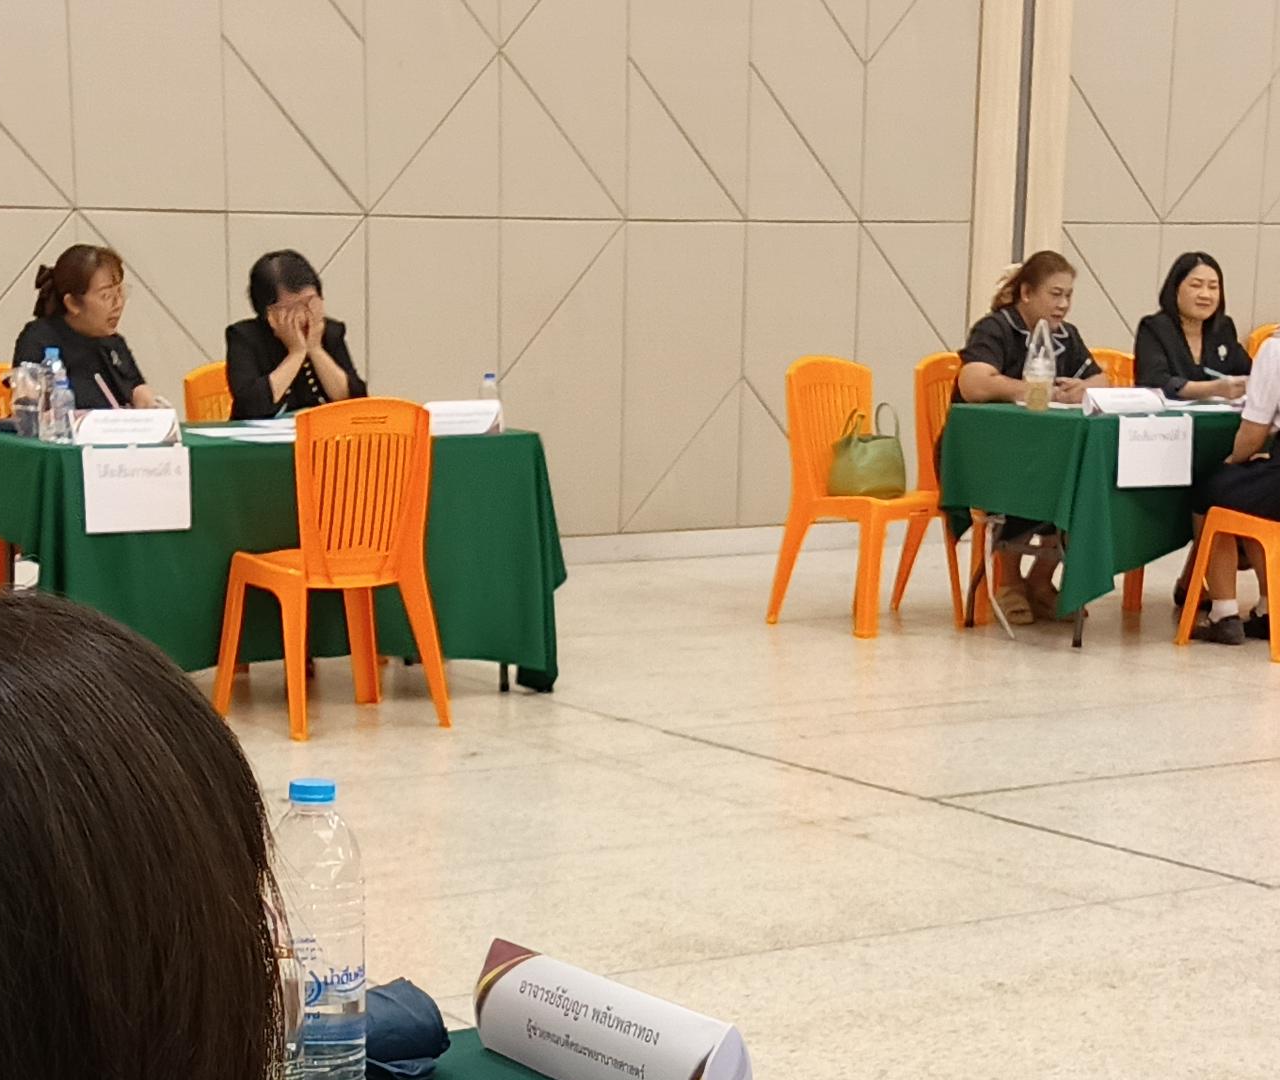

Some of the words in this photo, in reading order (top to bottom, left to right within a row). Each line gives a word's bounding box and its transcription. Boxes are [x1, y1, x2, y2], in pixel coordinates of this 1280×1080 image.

[519, 979, 589, 1022] อาจารย์ธัญญา
[591, 1005, 660, 1045] พลับพลาทอง
